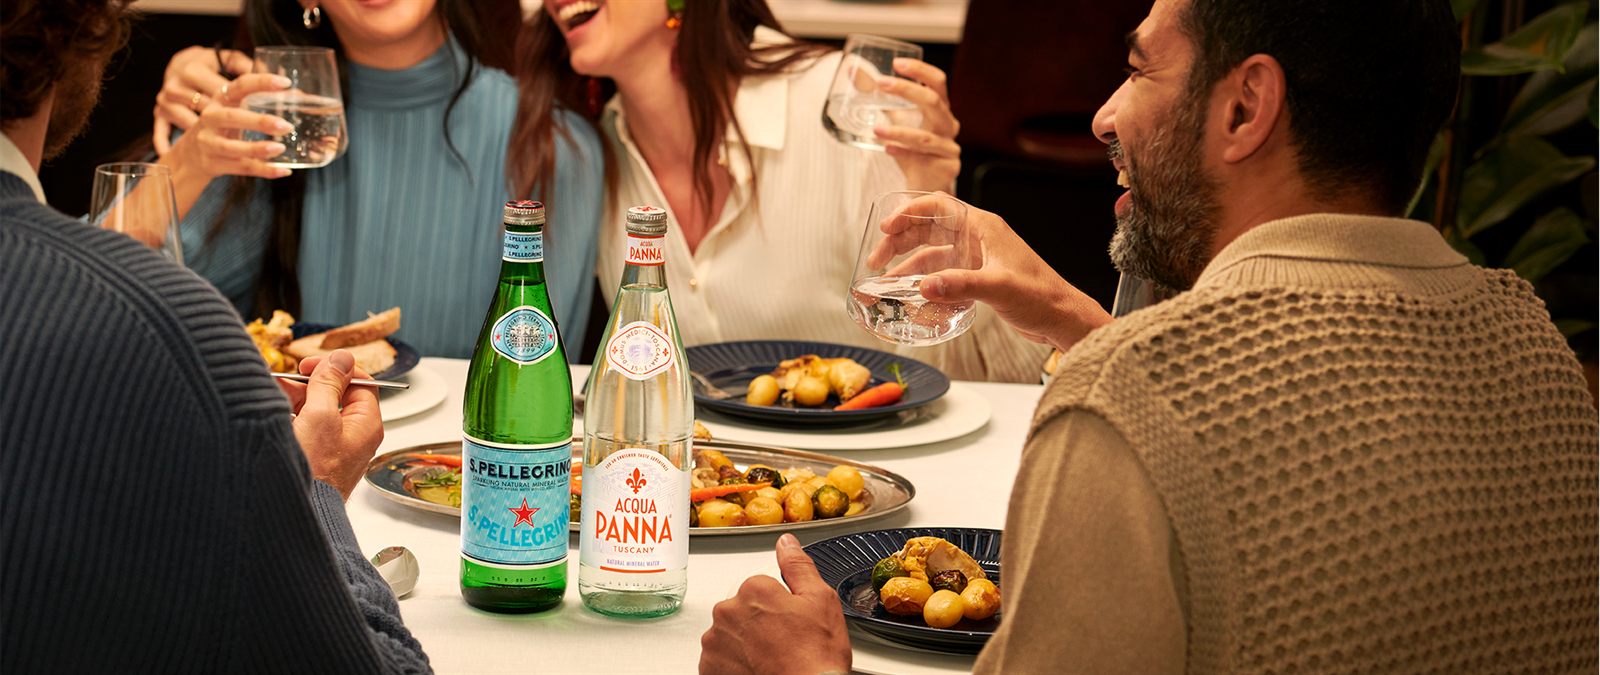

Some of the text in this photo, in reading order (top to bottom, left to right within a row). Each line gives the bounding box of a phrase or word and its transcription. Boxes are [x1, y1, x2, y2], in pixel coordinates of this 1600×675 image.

[630, 246, 662, 261] PANNA
[620, 340, 628, 364] DOMUS
[626, 330, 649, 340] MEDICI
[650, 335, 661, 366] TOSCANA
[469, 458, 571, 480] S.PELLEGRINO
[532, 480, 557, 488] MINERAL
[614, 498, 657, 514] ACQUA
[595, 510, 673, 545] PANNA
[613, 546, 655, 554] TUSCANY
[606, 559, 625, 567] NATURAL
